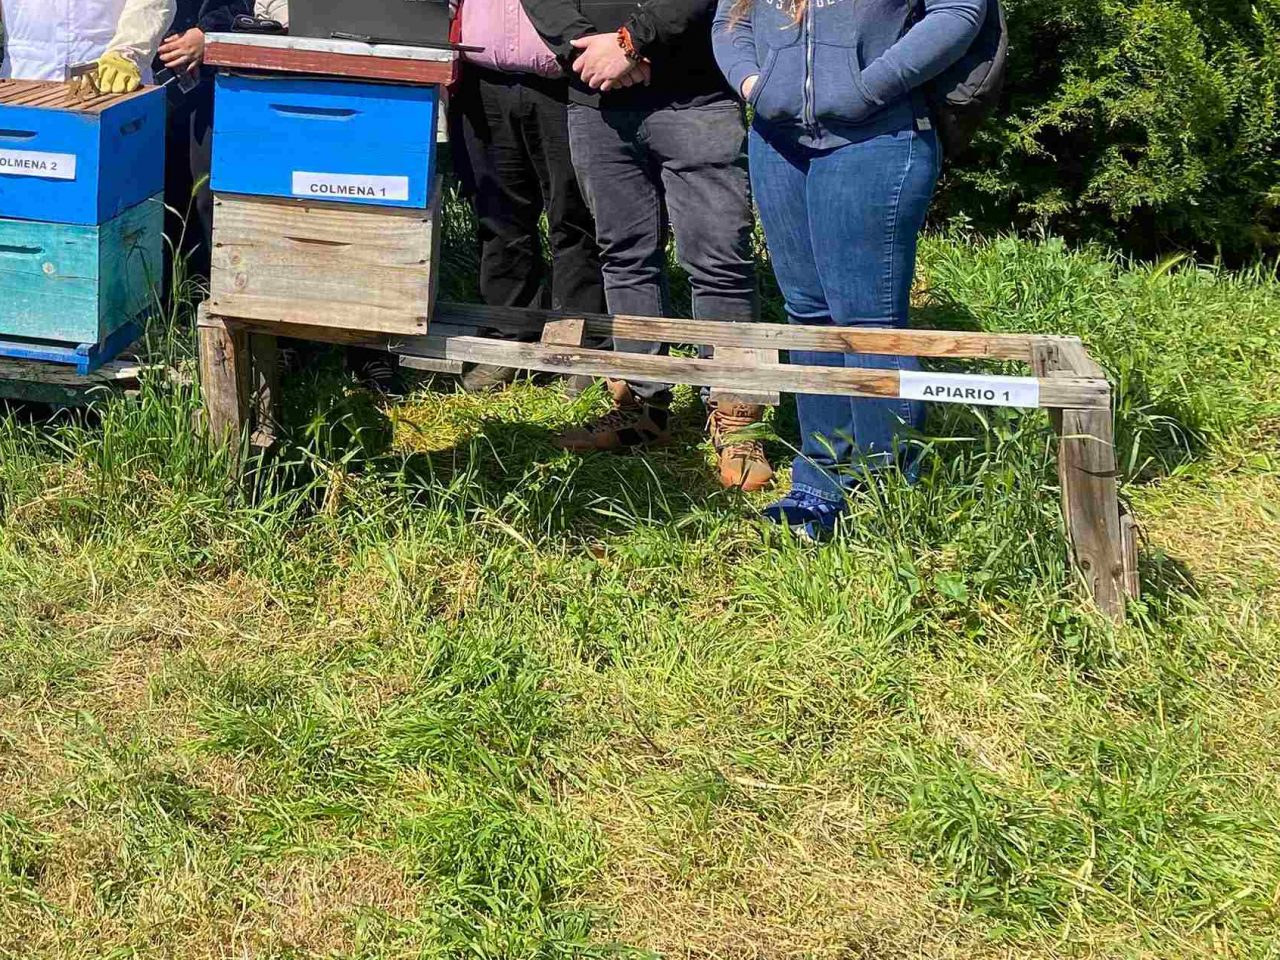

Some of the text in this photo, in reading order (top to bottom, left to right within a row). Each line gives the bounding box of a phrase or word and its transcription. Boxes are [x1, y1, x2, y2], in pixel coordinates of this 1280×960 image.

[50, 161, 58, 171] 2
[310, 183, 387, 197] COLMENA 1
[922, 385, 1010, 402] APIARIO 1
